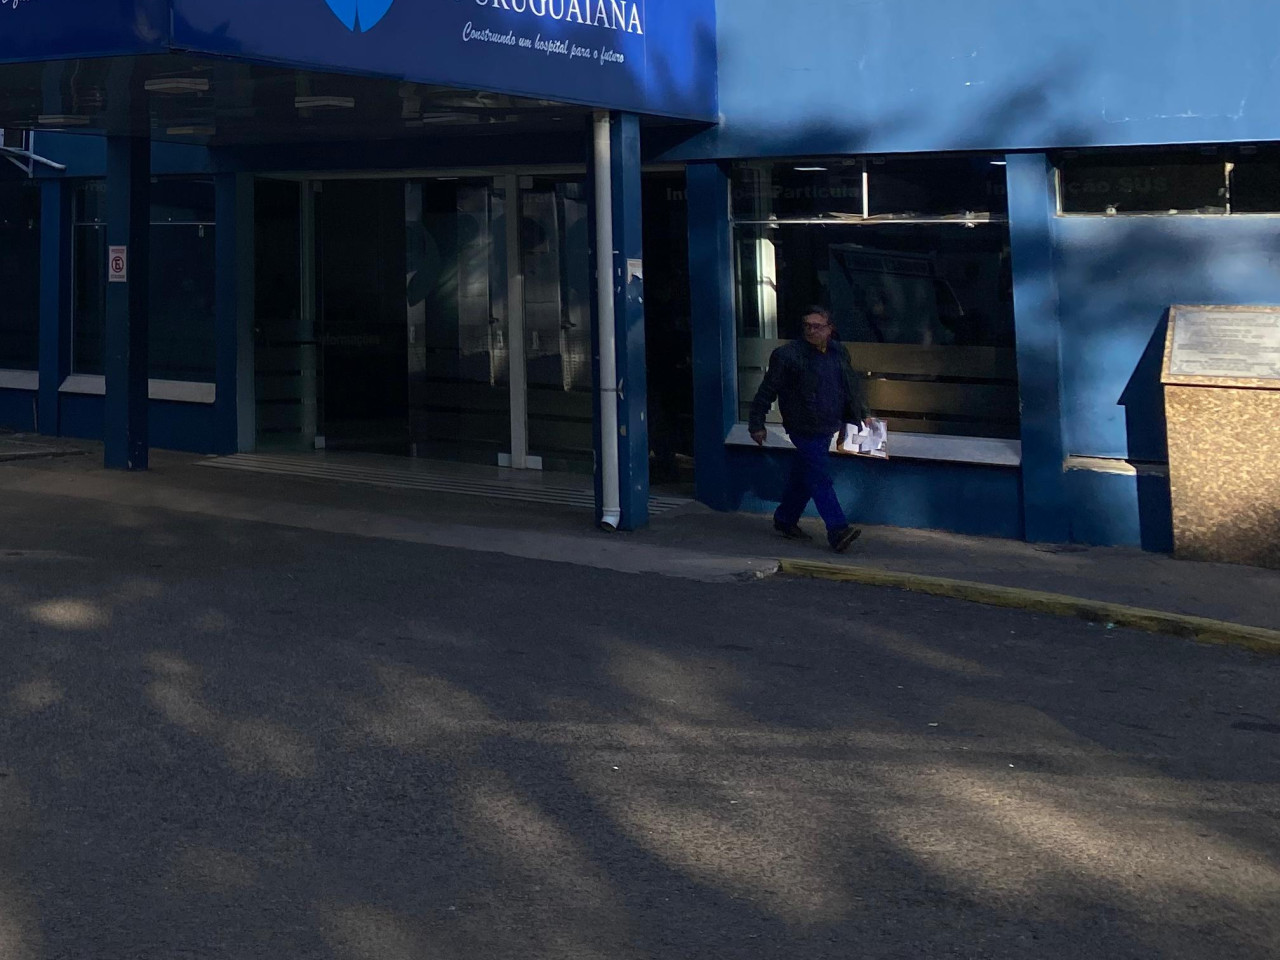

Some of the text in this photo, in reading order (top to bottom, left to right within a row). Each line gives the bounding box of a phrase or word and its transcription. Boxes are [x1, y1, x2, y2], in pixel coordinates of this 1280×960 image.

[462, 21, 625, 66] Construindo um hospital para o futuro
